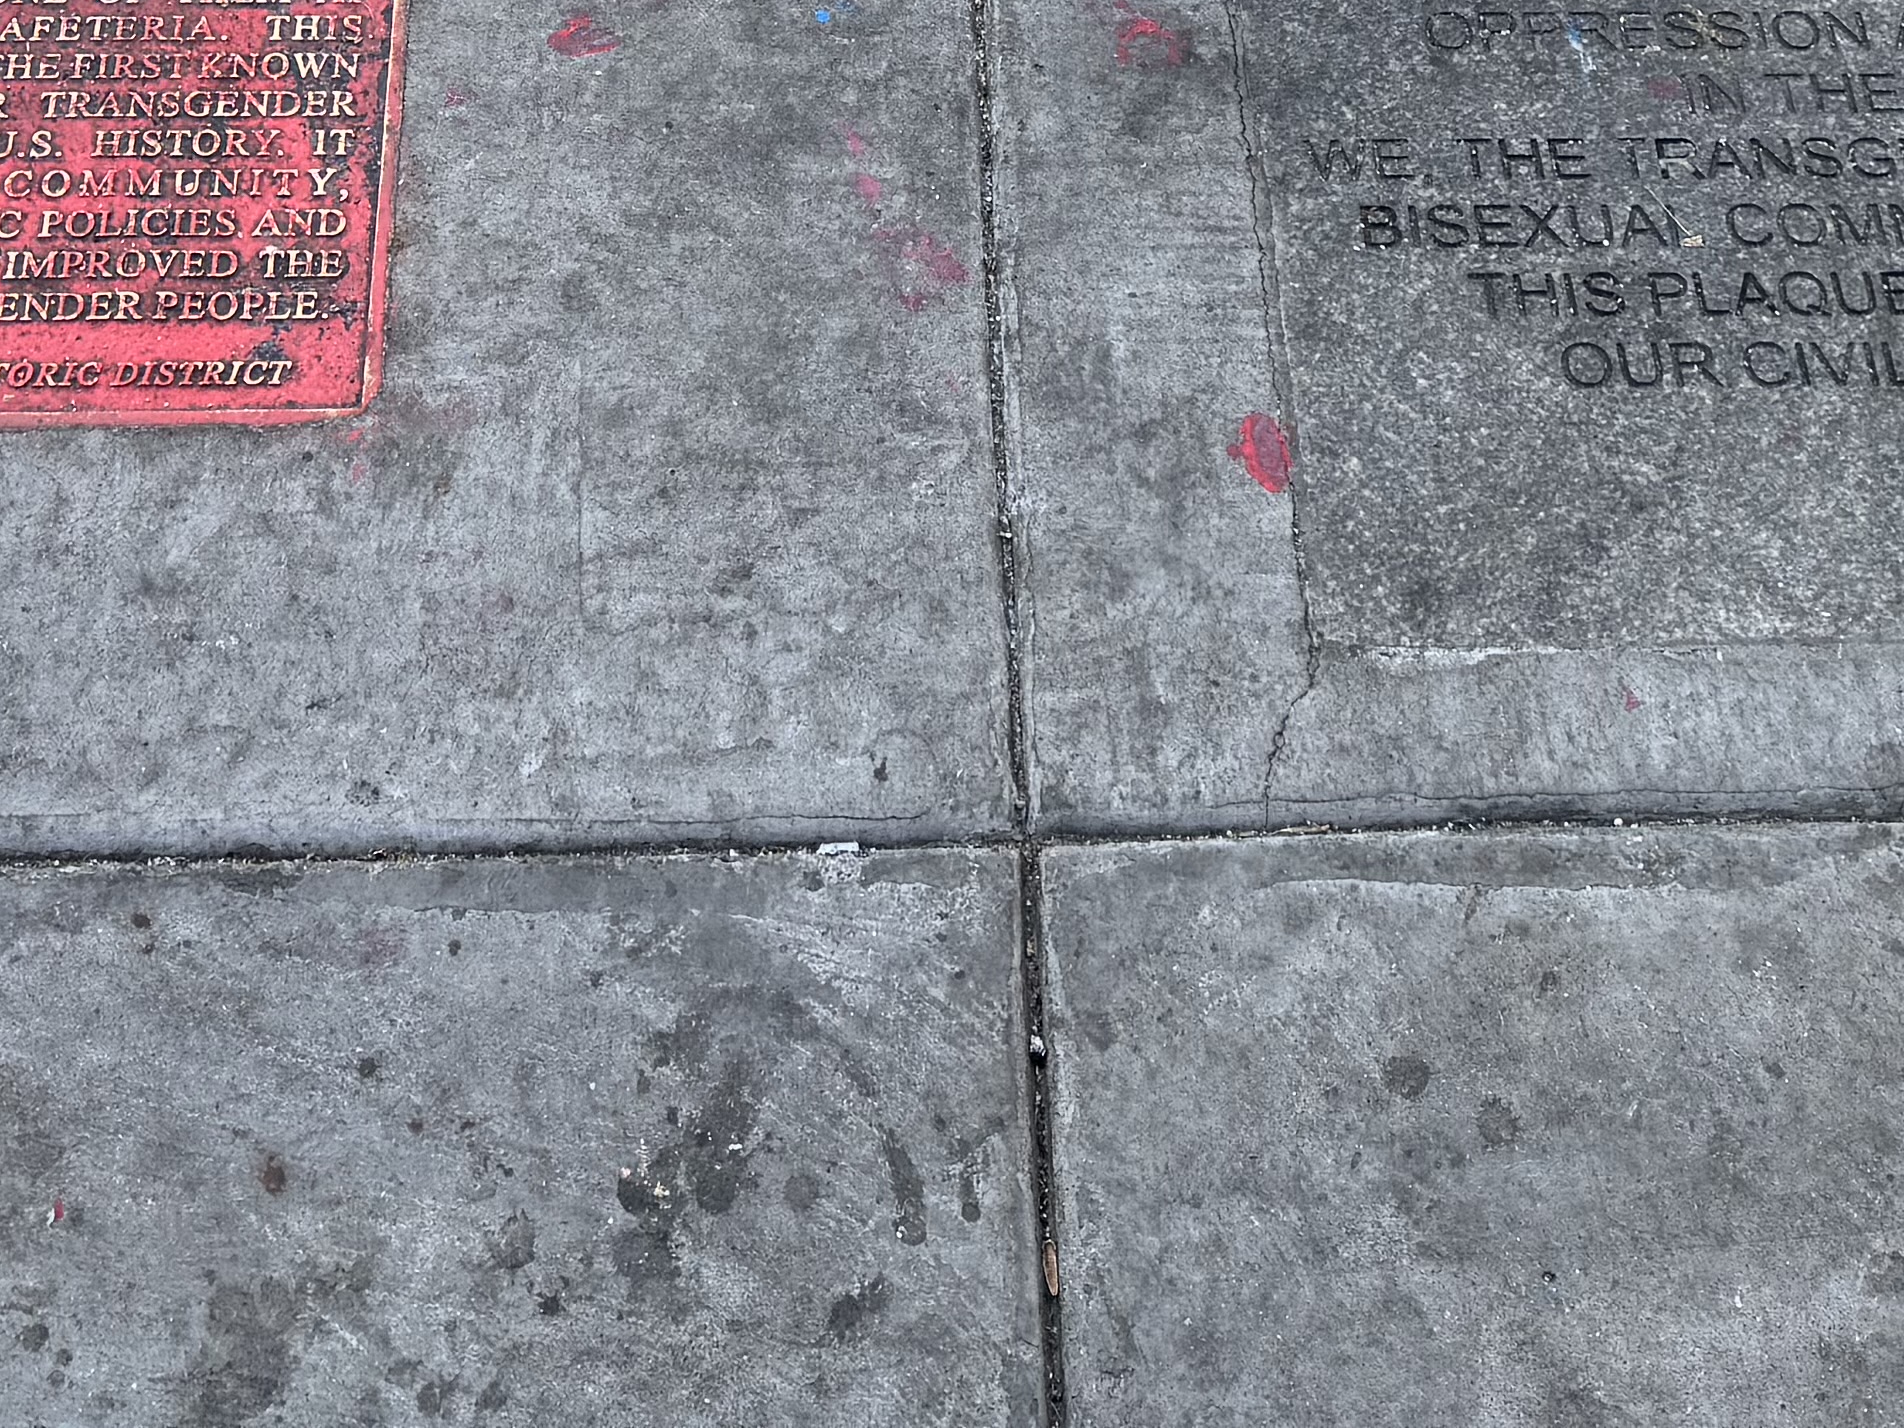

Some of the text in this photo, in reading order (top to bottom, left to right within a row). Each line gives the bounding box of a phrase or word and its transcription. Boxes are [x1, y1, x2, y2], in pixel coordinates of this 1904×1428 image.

[1425, 11, 1870, 48] OPPRESSION
[71, 54, 187, 80] FIRST
[195, 53, 362, 80] KNOWN
[40, 90, 359, 118] TRANSGENDER
[1684, 74, 1746, 113] IN
[1766, 73, 1902, 113] THE
[92, 130, 288, 158] HISTORY.
[310, 129, 357, 156] IT
[1457, 138, 1593, 180] THE
[3, 170, 350, 203] COMMUNITY,
[250, 209, 348, 238] AND
[1358, 203, 1690, 249] BISEXUAL
[2, 251, 240, 282] IMPROVED
[257, 250, 345, 280] THE
[152, 292, 333, 324] PEOPLE.
[1465, 271, 1626, 318] THIS
[108, 360, 294, 388] DISTRICT
[1559, 343, 1724, 389] OUR
